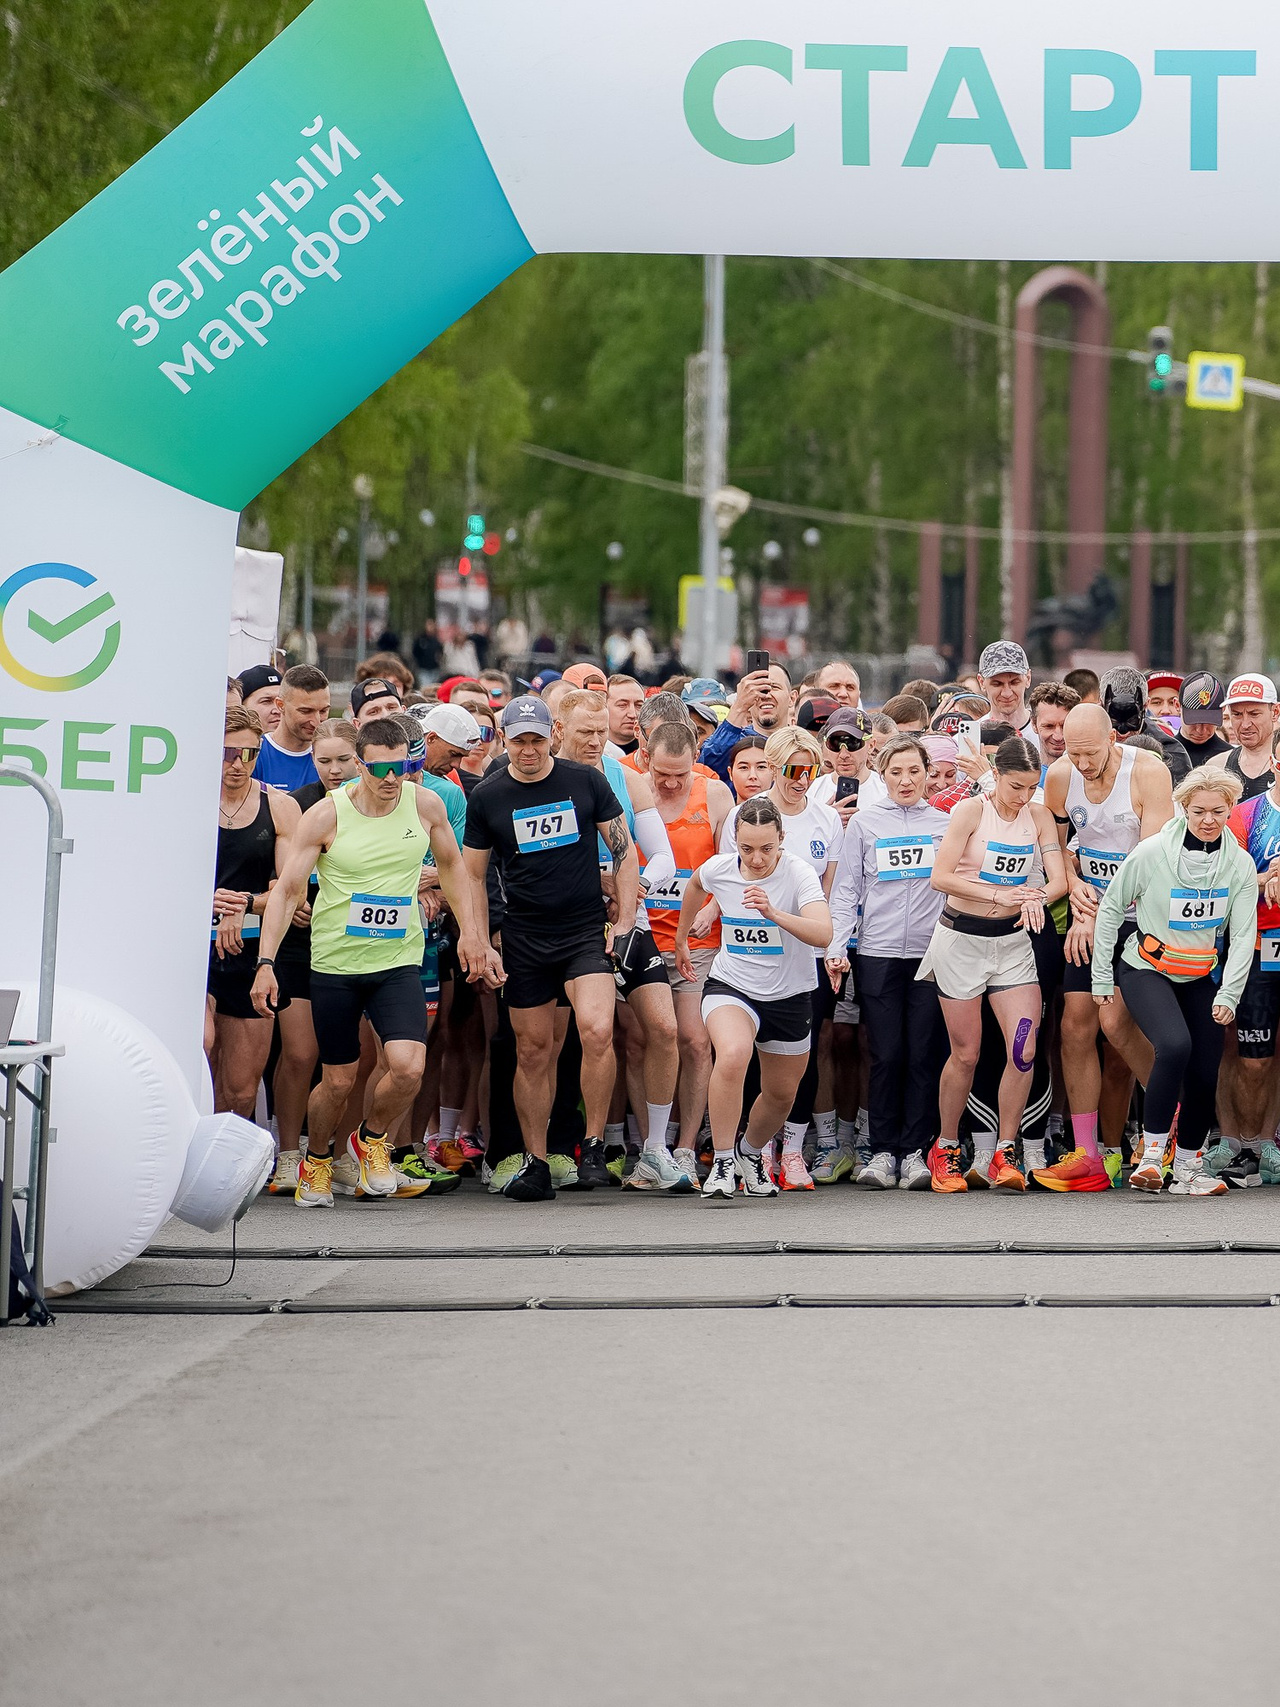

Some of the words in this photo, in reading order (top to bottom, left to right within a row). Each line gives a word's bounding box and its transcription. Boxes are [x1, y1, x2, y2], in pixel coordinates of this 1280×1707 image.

[682, 39, 1257, 171] СТАРТ
[116, 114, 362, 347] зелёный
[158, 172, 404, 395] марафон
[1230, 681, 1263, 697] ciele
[0, 716, 178, 793] БЕР
[526, 814, 563, 838] 767
[889, 848, 924, 866] 557
[994, 856, 1026, 874] 587
[361, 907, 398, 925] 803
[1182, 902, 1214, 918] 681
[734, 928, 769, 944] 848
